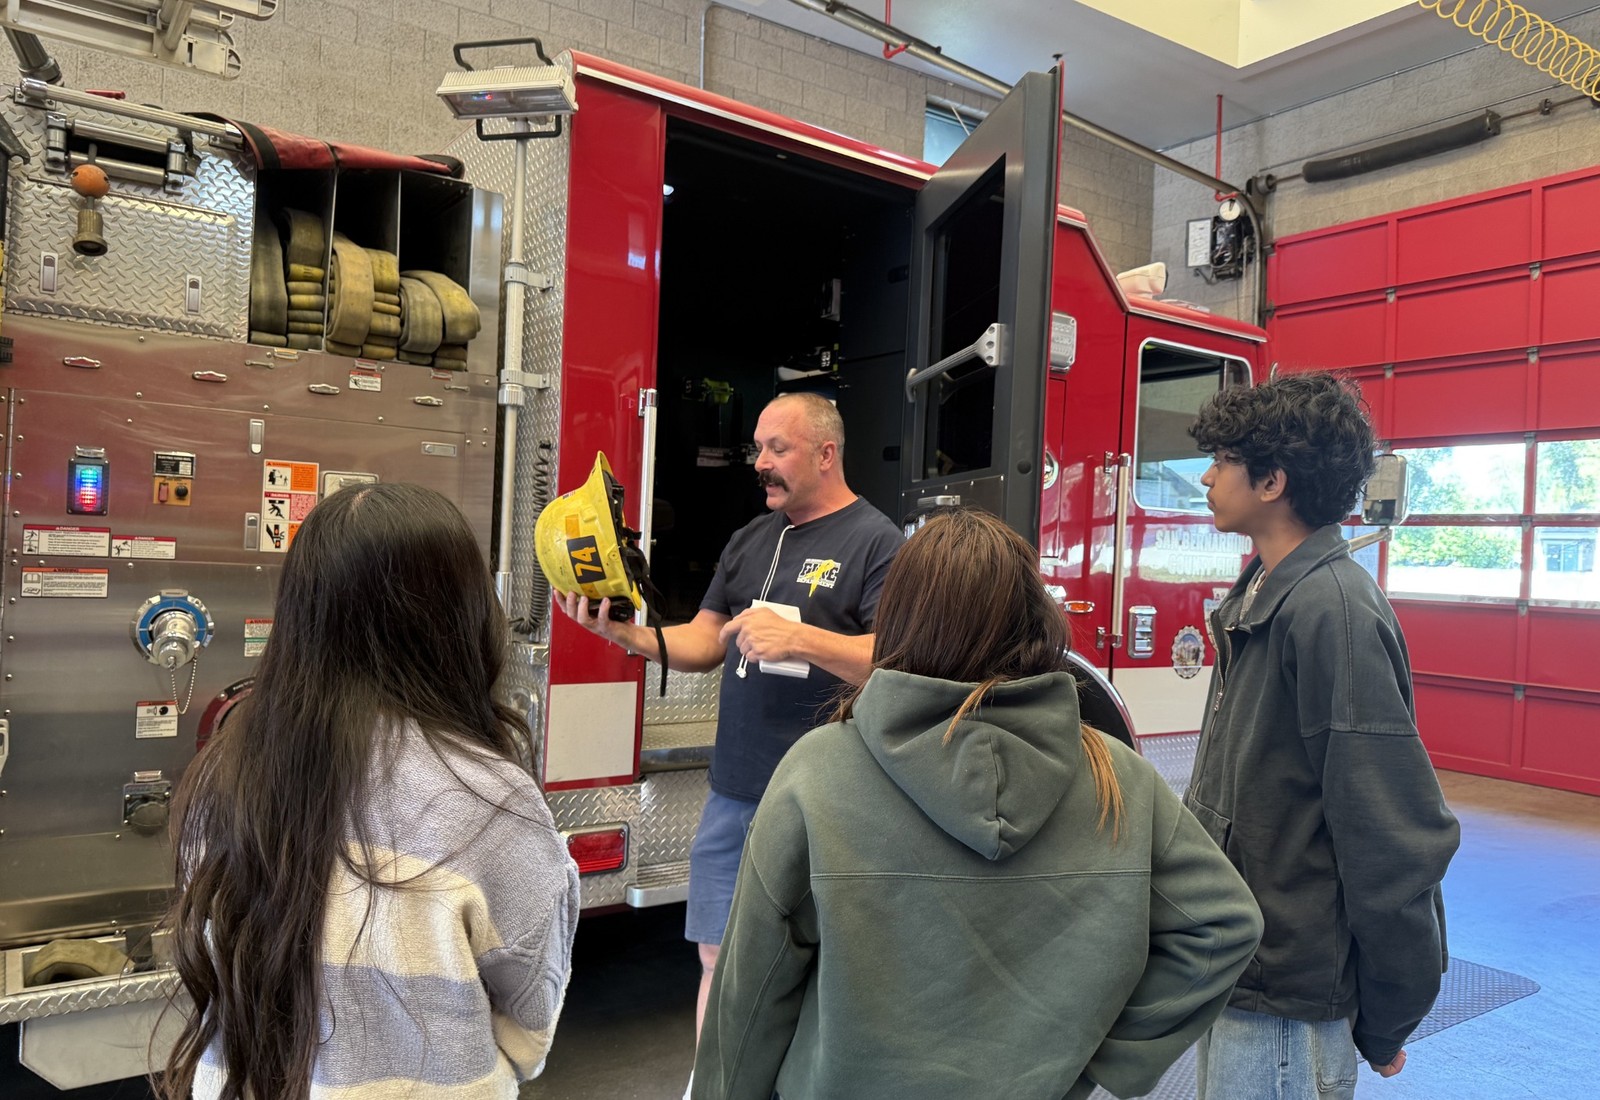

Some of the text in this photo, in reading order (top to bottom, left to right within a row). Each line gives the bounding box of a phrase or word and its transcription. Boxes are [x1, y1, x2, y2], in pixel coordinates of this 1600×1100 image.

[1156, 530, 1253, 555] SAN BERNARDINO
[571, 546, 603, 577] 74
[1168, 554, 1241, 577] COUNTY FIRE
